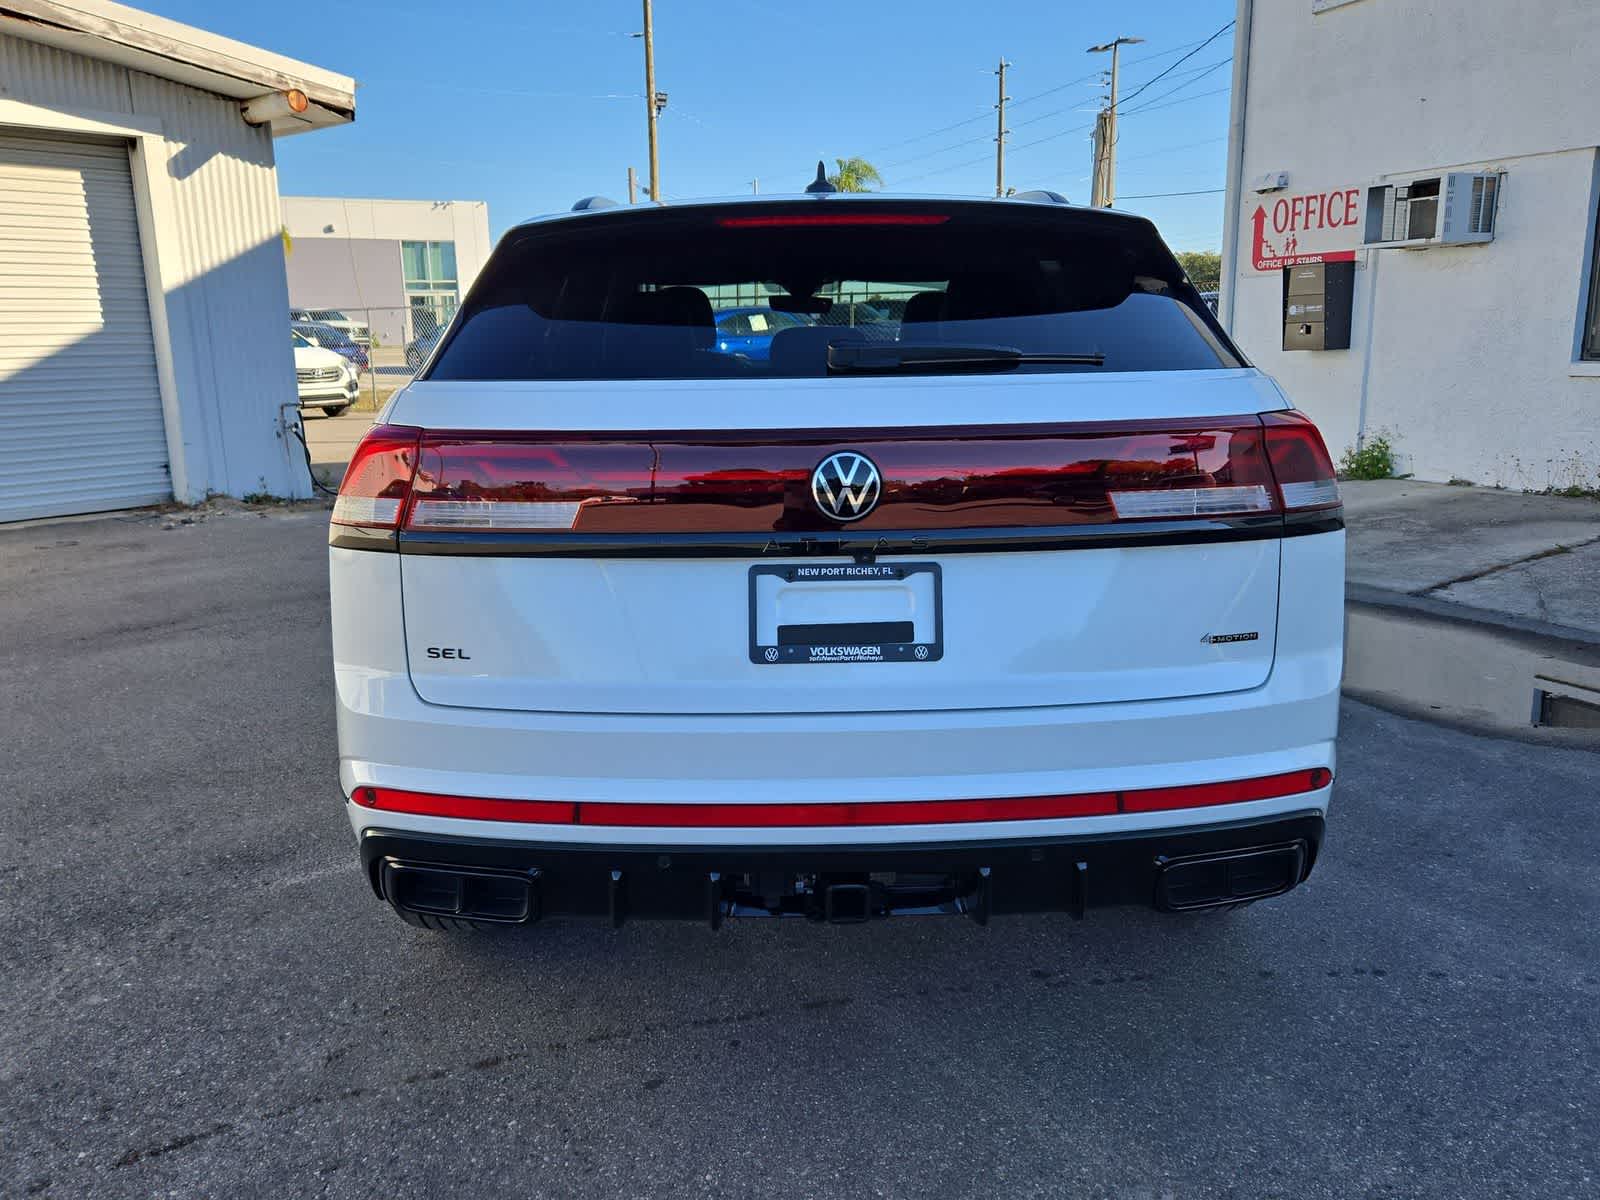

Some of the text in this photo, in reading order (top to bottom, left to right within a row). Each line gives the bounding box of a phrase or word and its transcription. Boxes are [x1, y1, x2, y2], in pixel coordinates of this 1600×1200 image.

[1273, 189, 1360, 234] OFFICE
[1257, 259, 1282, 269] OFFICE
[797, 567, 893, 576] NEW PORT RICHEY, FL
[427, 647, 471, 660] SEL
[809, 646, 881, 656] VOLKSWAGEN
